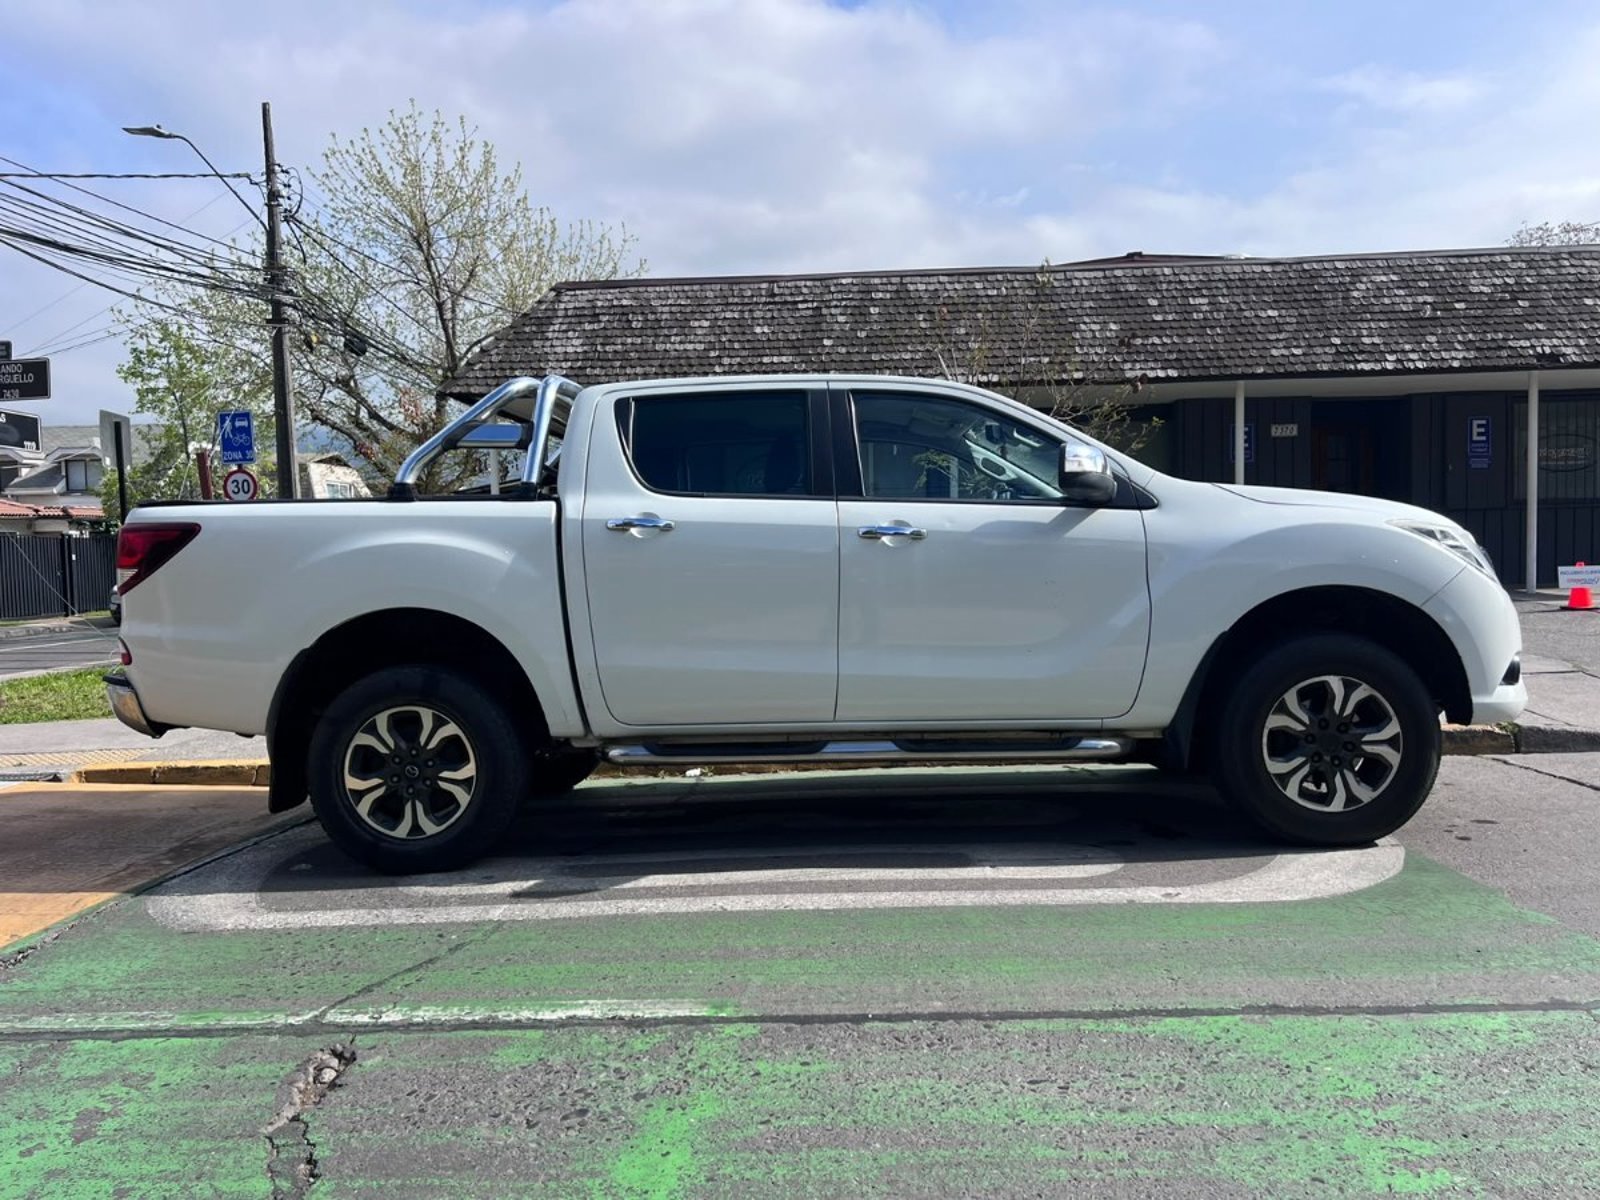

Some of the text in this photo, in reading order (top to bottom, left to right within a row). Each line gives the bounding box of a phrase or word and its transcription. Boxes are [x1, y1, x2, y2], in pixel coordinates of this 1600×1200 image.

[0, 364, 23, 373] ANDO
[0, 373, 34, 384] RGUELLO
[1472, 420, 1487, 440] E
[223, 451, 243, 460] ZONA
[231, 479, 250, 494] 30
